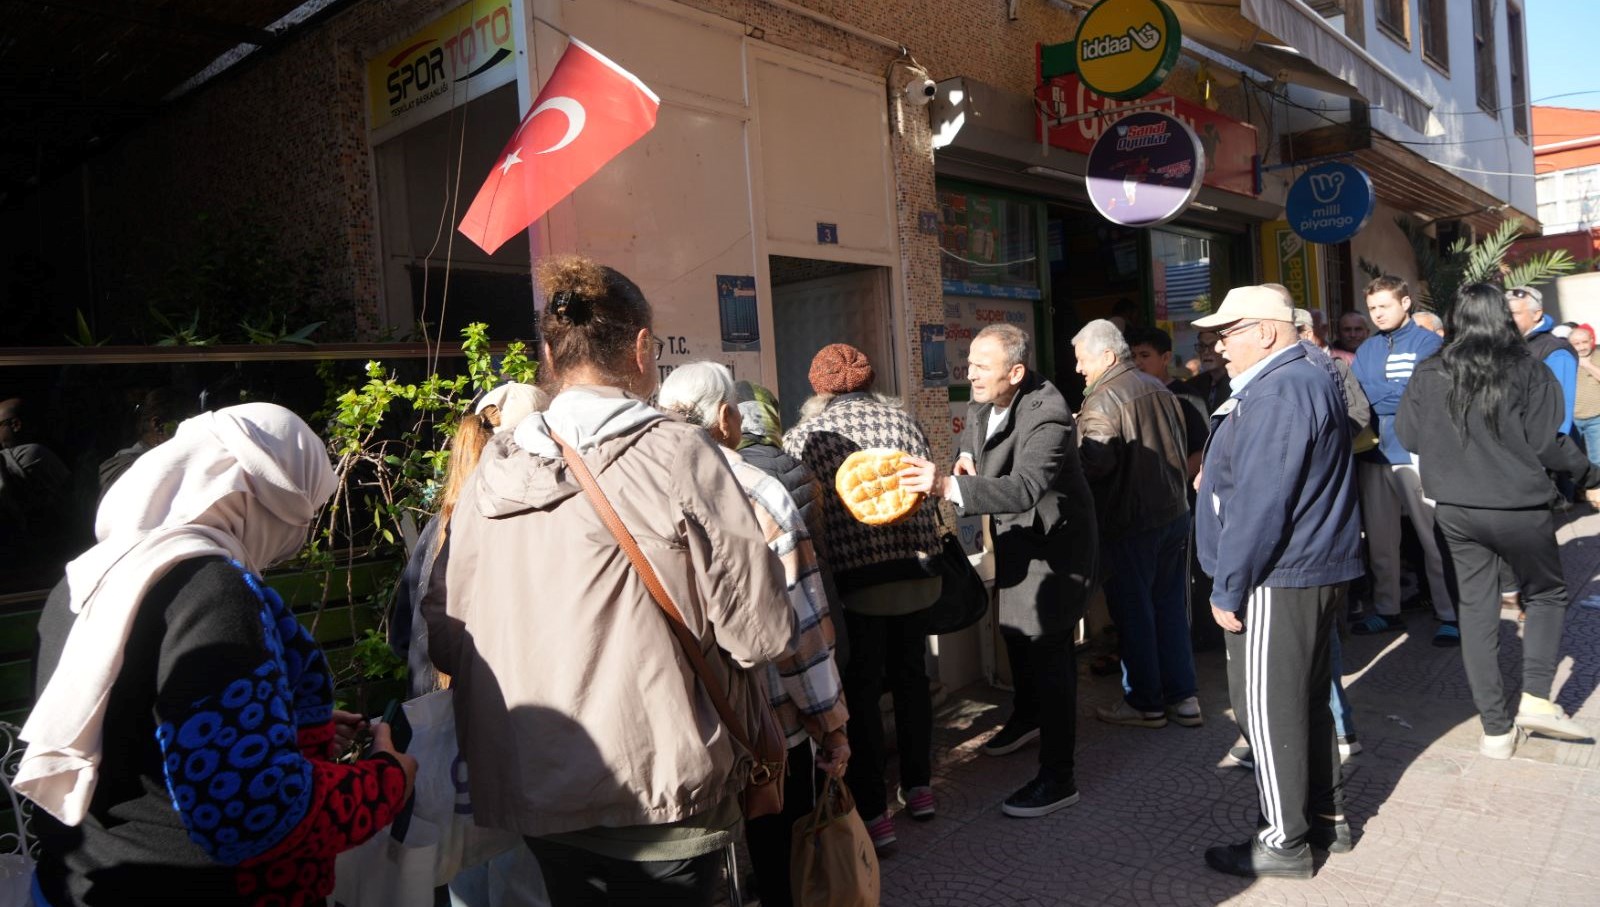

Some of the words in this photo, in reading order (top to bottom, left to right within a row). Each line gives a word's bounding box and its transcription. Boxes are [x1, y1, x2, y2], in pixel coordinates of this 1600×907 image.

[387, 47, 445, 106] SPOR
[443, 5, 511, 73] TOTO
[1082, 37, 1132, 61] iddaa
[1127, 120, 1168, 139] Sanal
[1116, 133, 1171, 152] Oyunlar
[1312, 204, 1341, 218] milli
[1300, 214, 1354, 232] piyango
[824, 228, 832, 242] 3
[667, 336, 691, 355] T.C.
